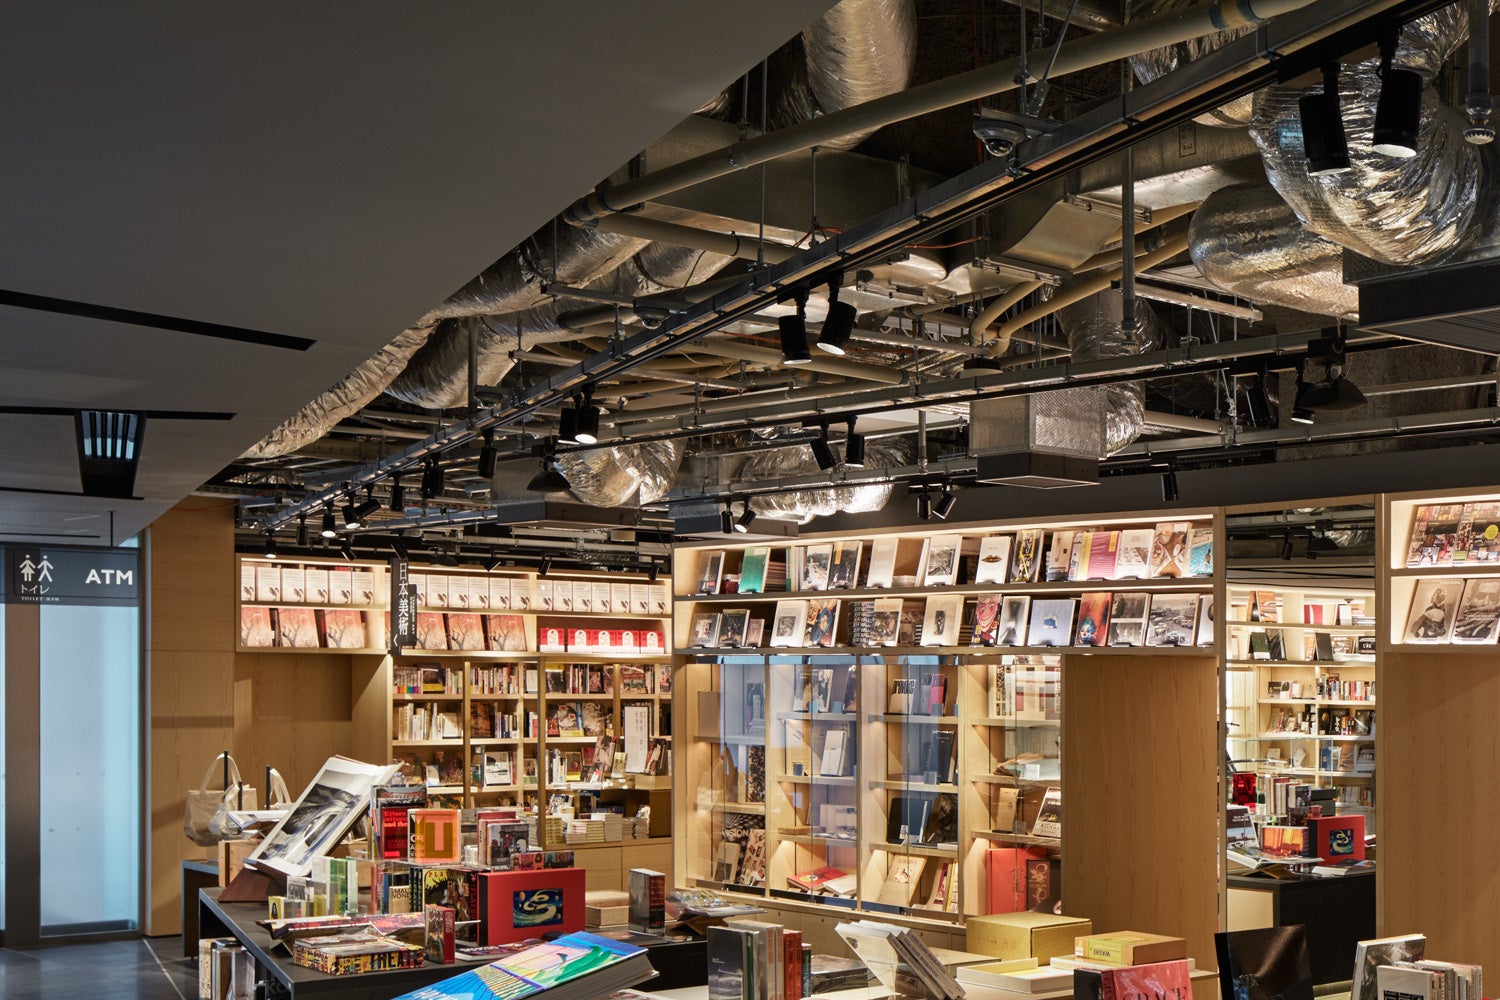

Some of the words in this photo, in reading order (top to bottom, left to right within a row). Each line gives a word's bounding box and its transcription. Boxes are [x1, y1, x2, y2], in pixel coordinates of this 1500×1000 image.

[85, 568, 133, 586] ATM
[20, 584, 50, 594] トイレ
[398, 562, 409, 636] 日本美術
[1093, 949, 1111, 958] WASHI
